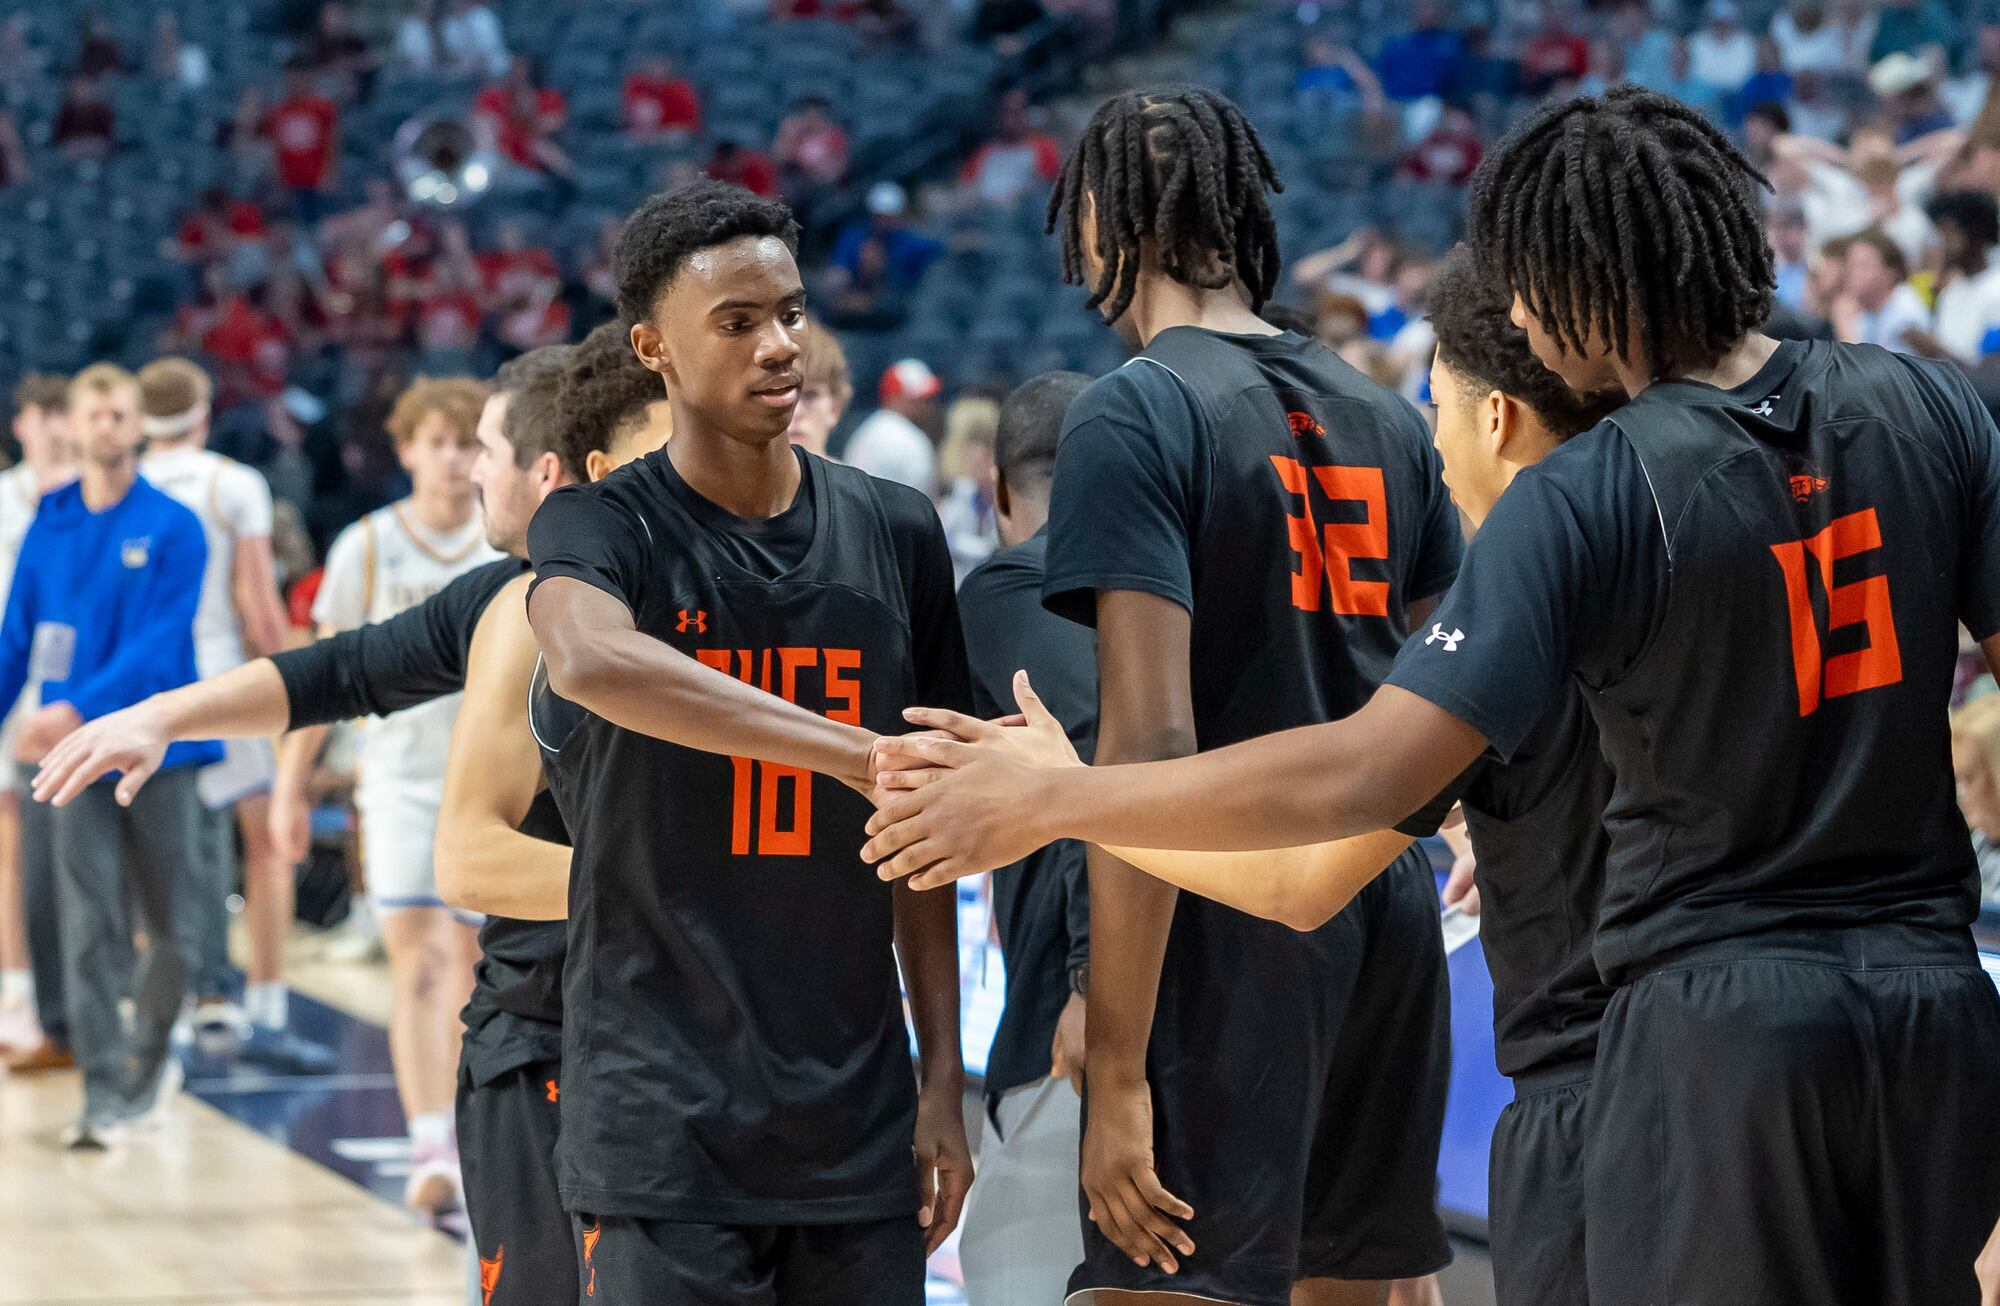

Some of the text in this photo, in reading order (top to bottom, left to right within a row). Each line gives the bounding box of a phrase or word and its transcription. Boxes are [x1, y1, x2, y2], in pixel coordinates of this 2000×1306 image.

[1269, 454, 1390, 617] 32
[1769, 507, 1903, 718] 15
[730, 755, 812, 856] 10
